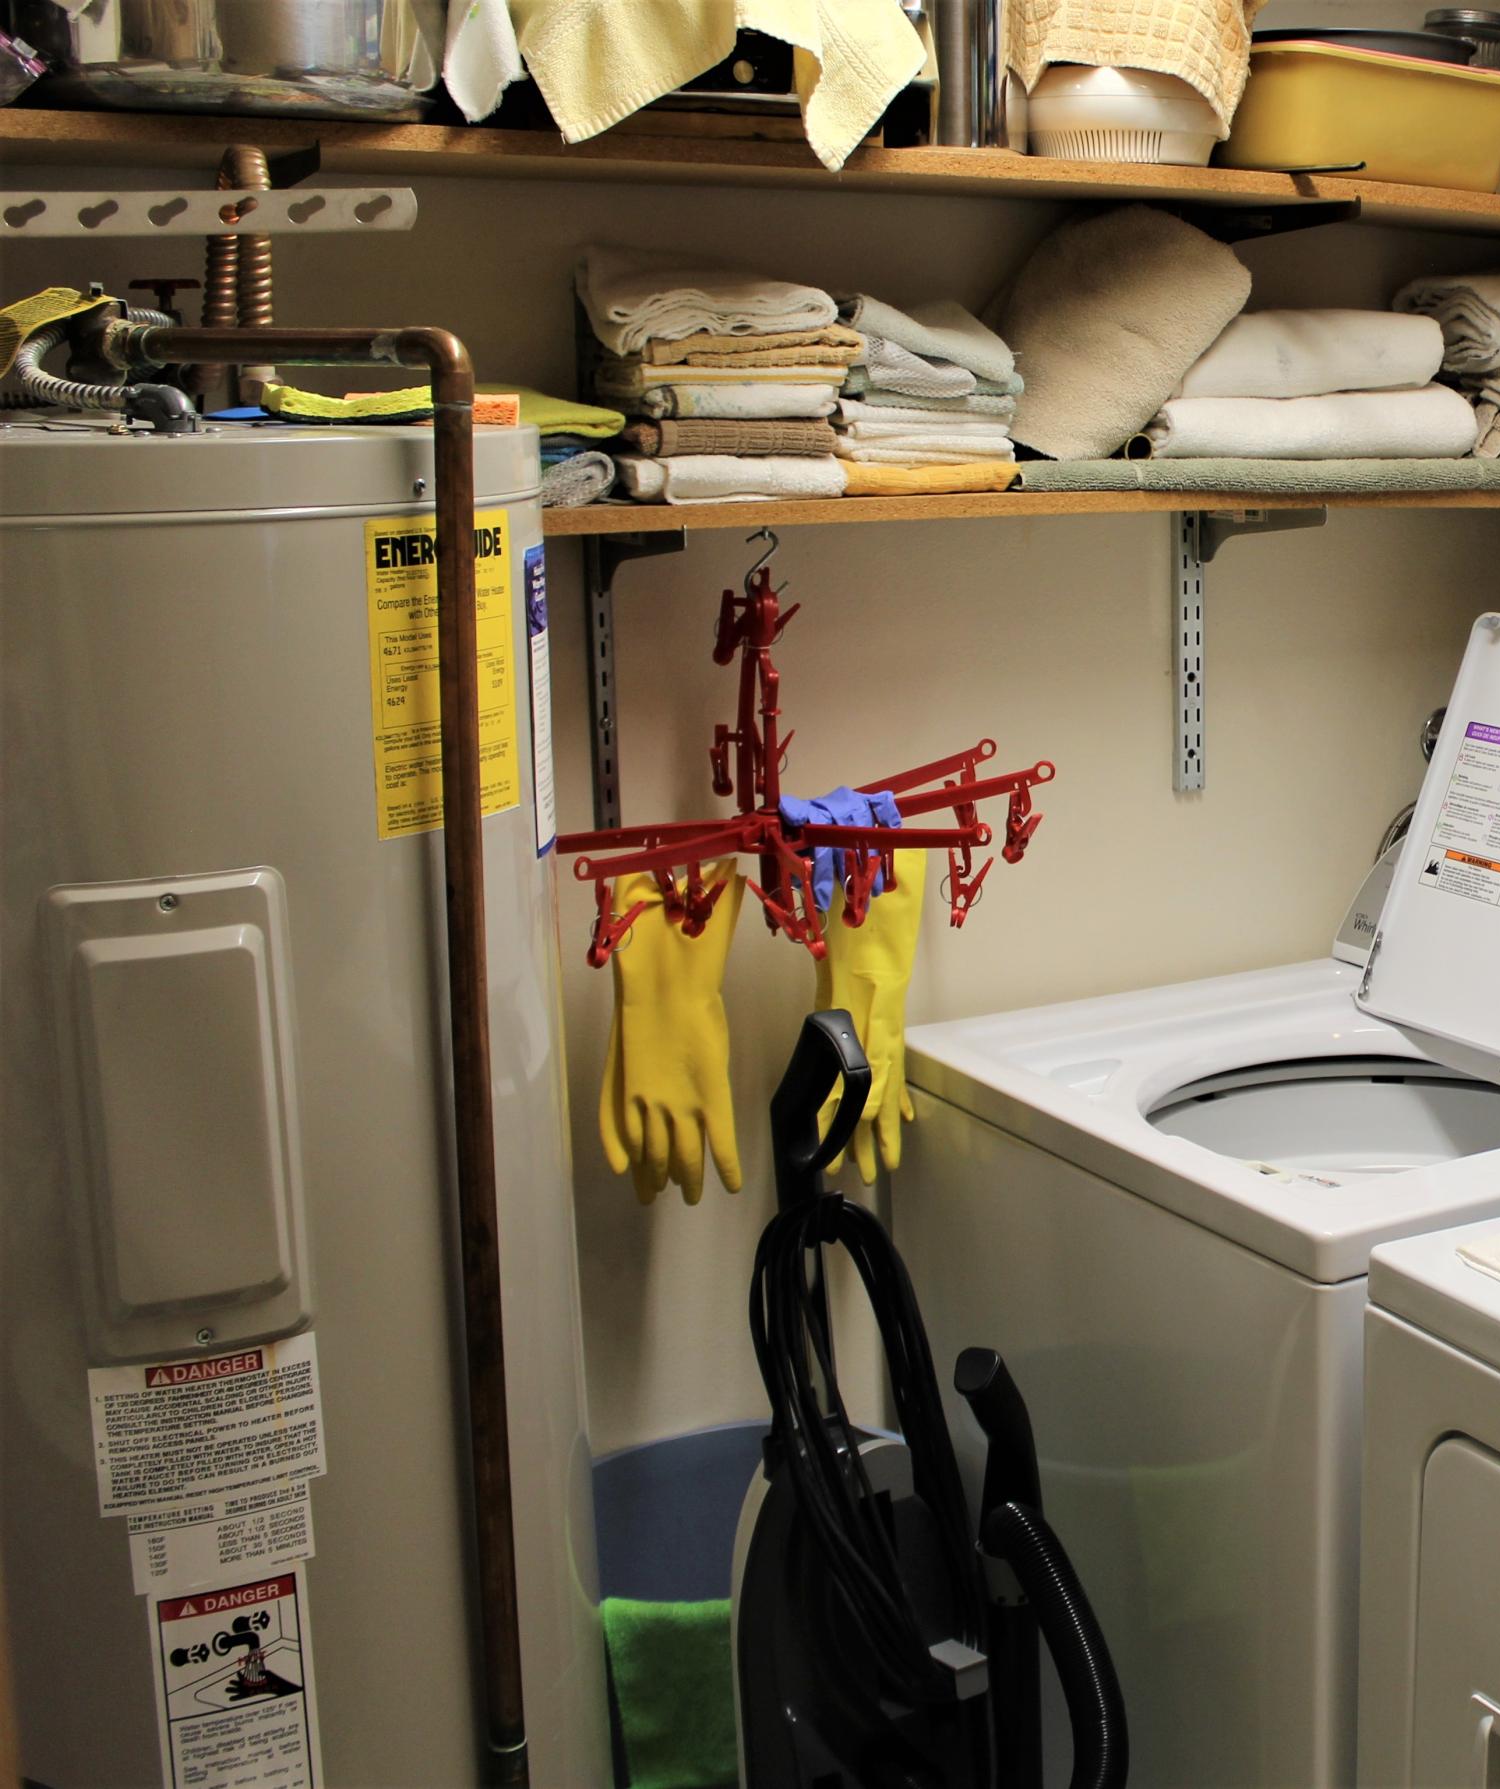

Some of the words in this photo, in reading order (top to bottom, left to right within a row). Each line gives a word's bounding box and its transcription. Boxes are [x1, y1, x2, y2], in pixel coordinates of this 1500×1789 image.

[377, 597, 410, 611] Compare
[411, 595, 423, 606] the
[408, 609, 423, 620] with
[384, 635, 399, 643] This
[399, 633, 417, 642] Model
[418, 632, 432, 640] Uses
[383, 645, 402, 656] 4671
[385, 676, 402, 684] Uses
[402, 674, 419, 682] Least
[386, 684, 409, 693] Energy
[384, 764, 408, 773] Electric
[1467, 857, 1492, 869] WARNING
[172, 1353, 257, 1381] DANGER
[104, 1392, 139, 1401] SETTING
[154, 1387, 182, 1396] WATER
[185, 1382, 216, 1392] HEATER
[219, 1370, 269, 1386] THERMOSTAT
[281, 1360, 310, 1372] EXCESS
[129, 1397, 164, 1406] DEGREES
[235, 1378, 267, 1390] DEGREES
[269, 1367, 310, 1383] CENTIGRADE
[124, 1406, 150, 1414] CAUSE
[153, 1399, 201, 1411] ACCIDENTAL
[204, 1391, 243, 1403] SCALDING
[258, 1381, 283, 1392] OTHER
[106, 1411, 166, 1423] PARTICULARLY
[181, 1403, 222, 1414] CHILDREN
[238, 1391, 272, 1404] ELDERLY
[106, 1421, 141, 1430] CONSULT
[160, 1412, 211, 1424] INSTRUCTION
[212, 1405, 243, 1416] MANUAL
[245, 1398, 274, 1410] BEFORE
[275, 1388, 313, 1403] CHANGING
[123, 1424, 180, 1435] TEMPERATURE
[203, 1582, 280, 1612] DANGER
